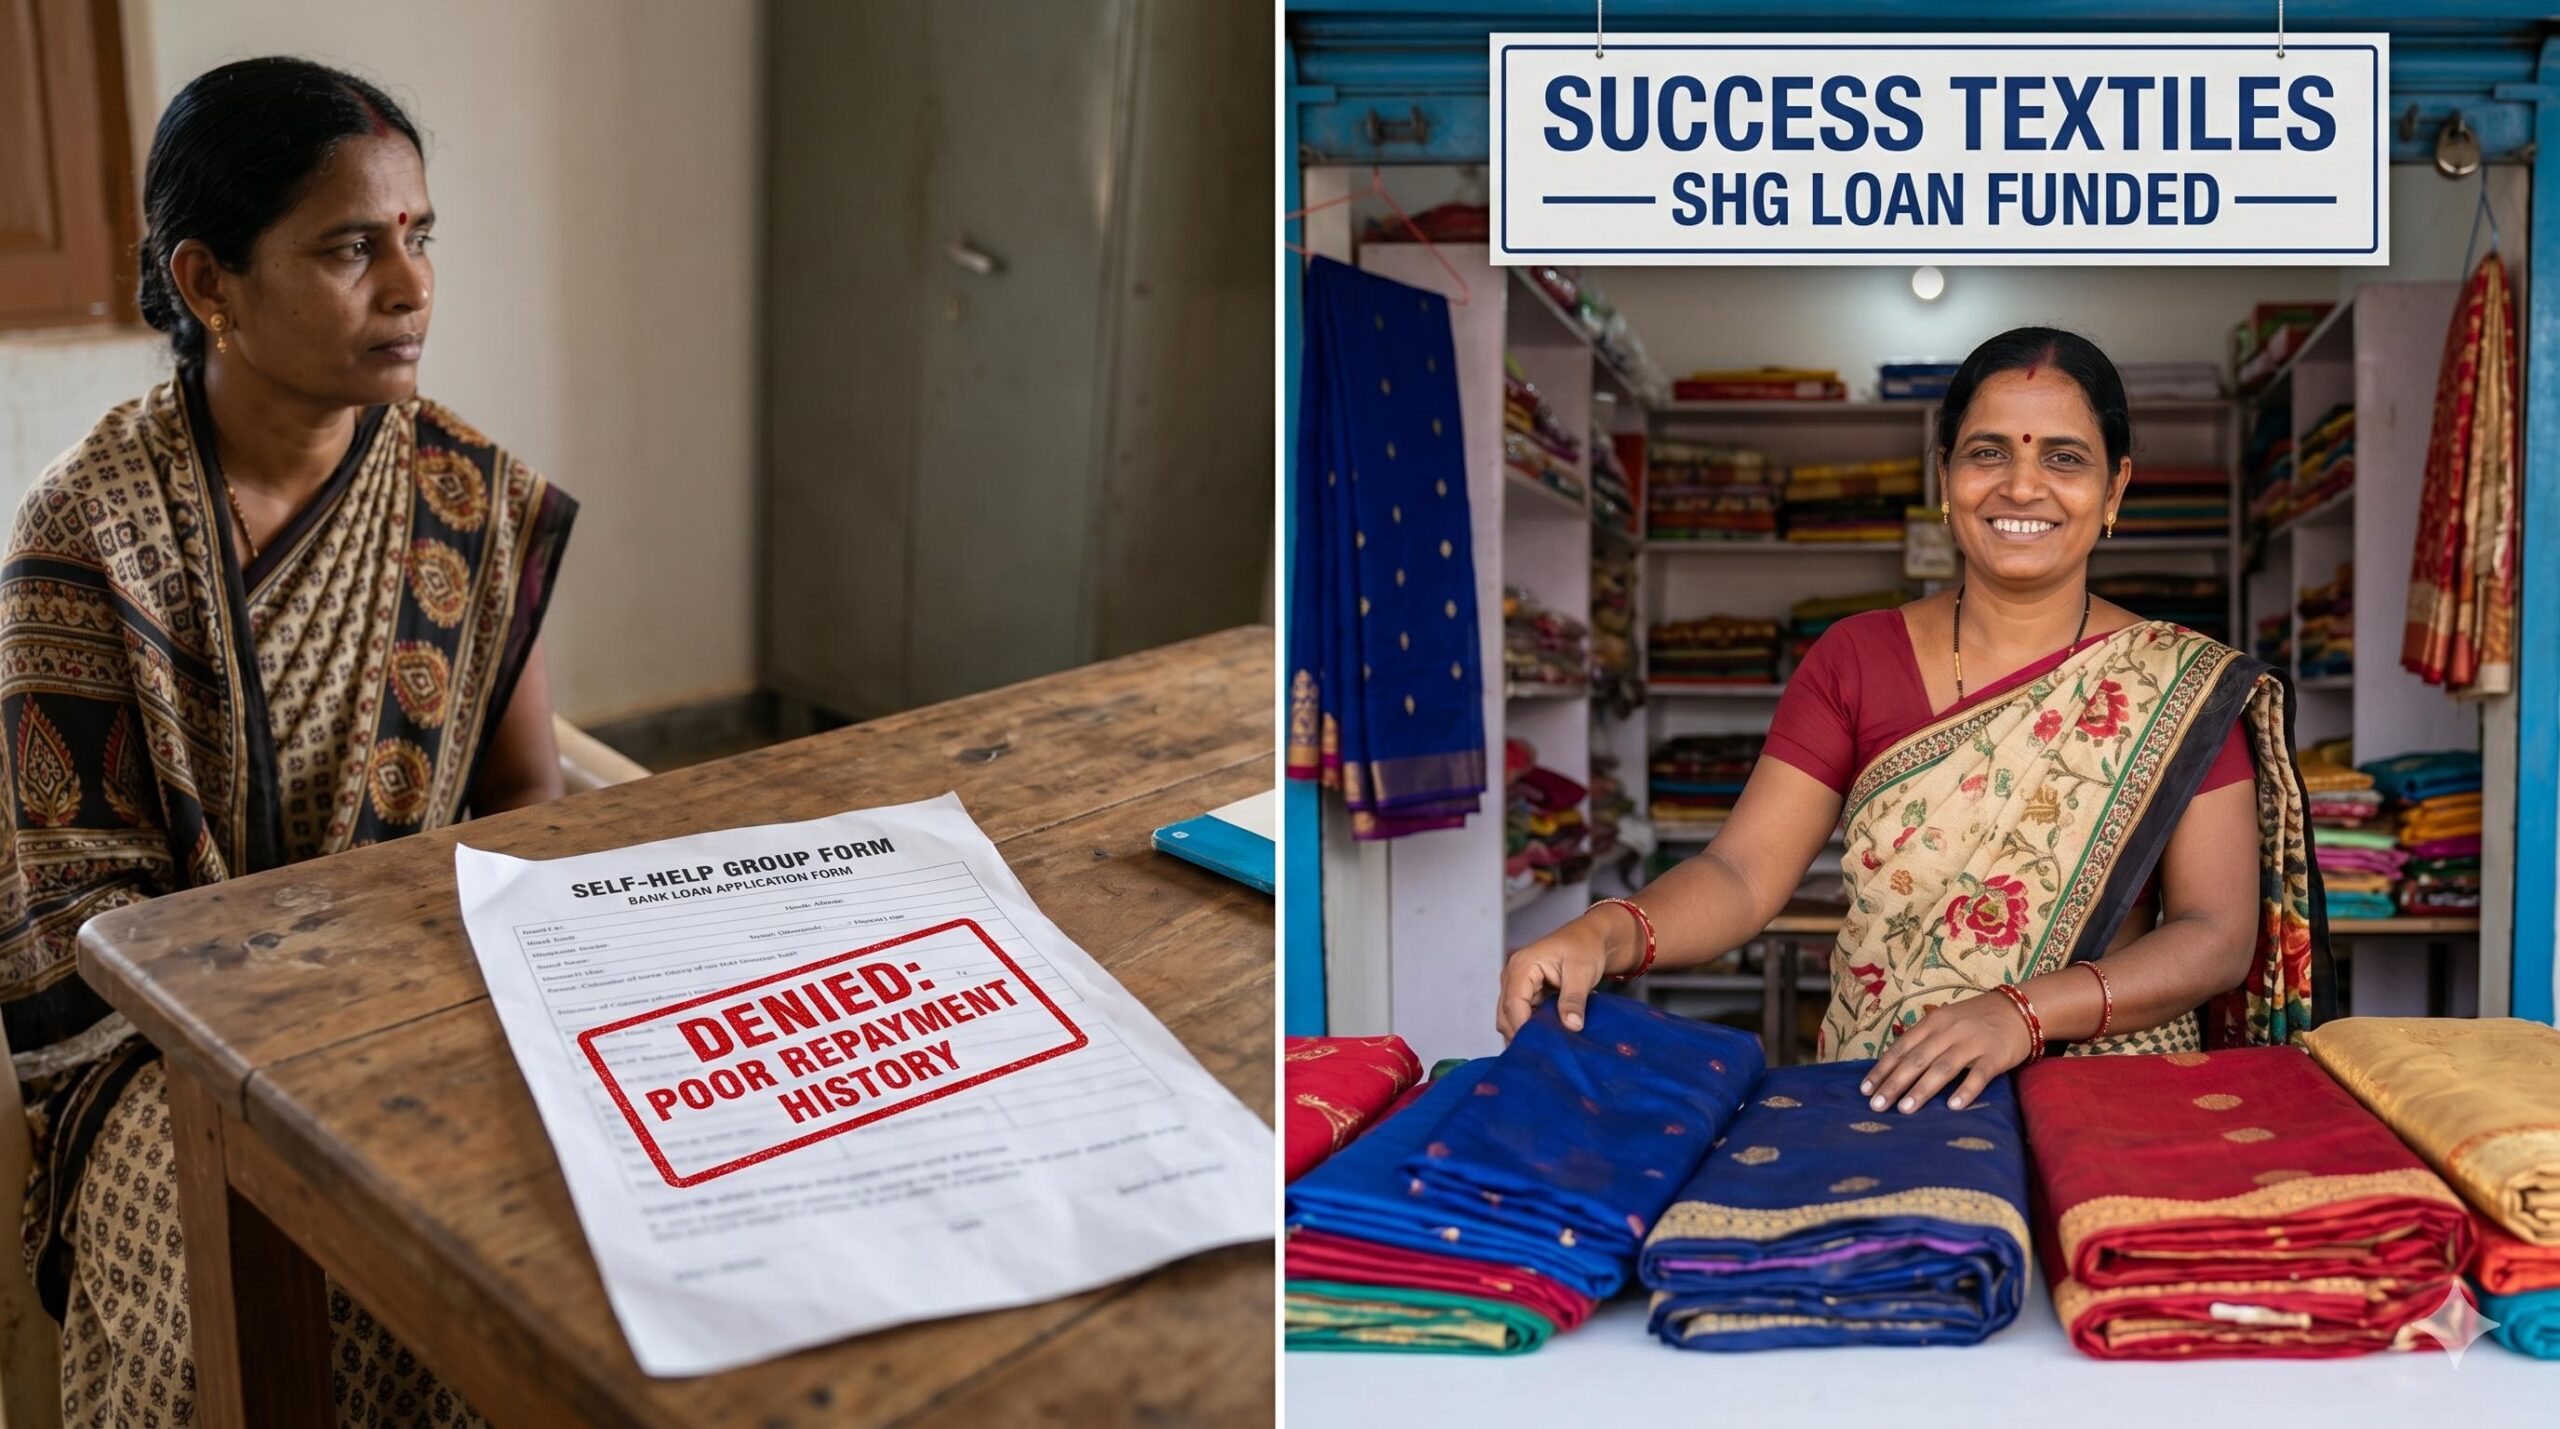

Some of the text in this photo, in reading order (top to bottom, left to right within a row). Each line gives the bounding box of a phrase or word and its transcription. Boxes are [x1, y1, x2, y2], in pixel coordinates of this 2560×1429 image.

[1543, 75, 2337, 152] SUCCESS TEXTILES
[1671, 172, 2220, 227] SHG LOAN FUNDED
[571, 837, 896, 900] SELF-HELP GROUP FORM
[628, 866, 853, 906] BANK LOAN APPLICATION FORM
[645, 978, 1019, 1122] POOR REPAYMENT
[676, 961, 935, 1063] DENIED:
[778, 1039, 959, 1124] HISTORY
